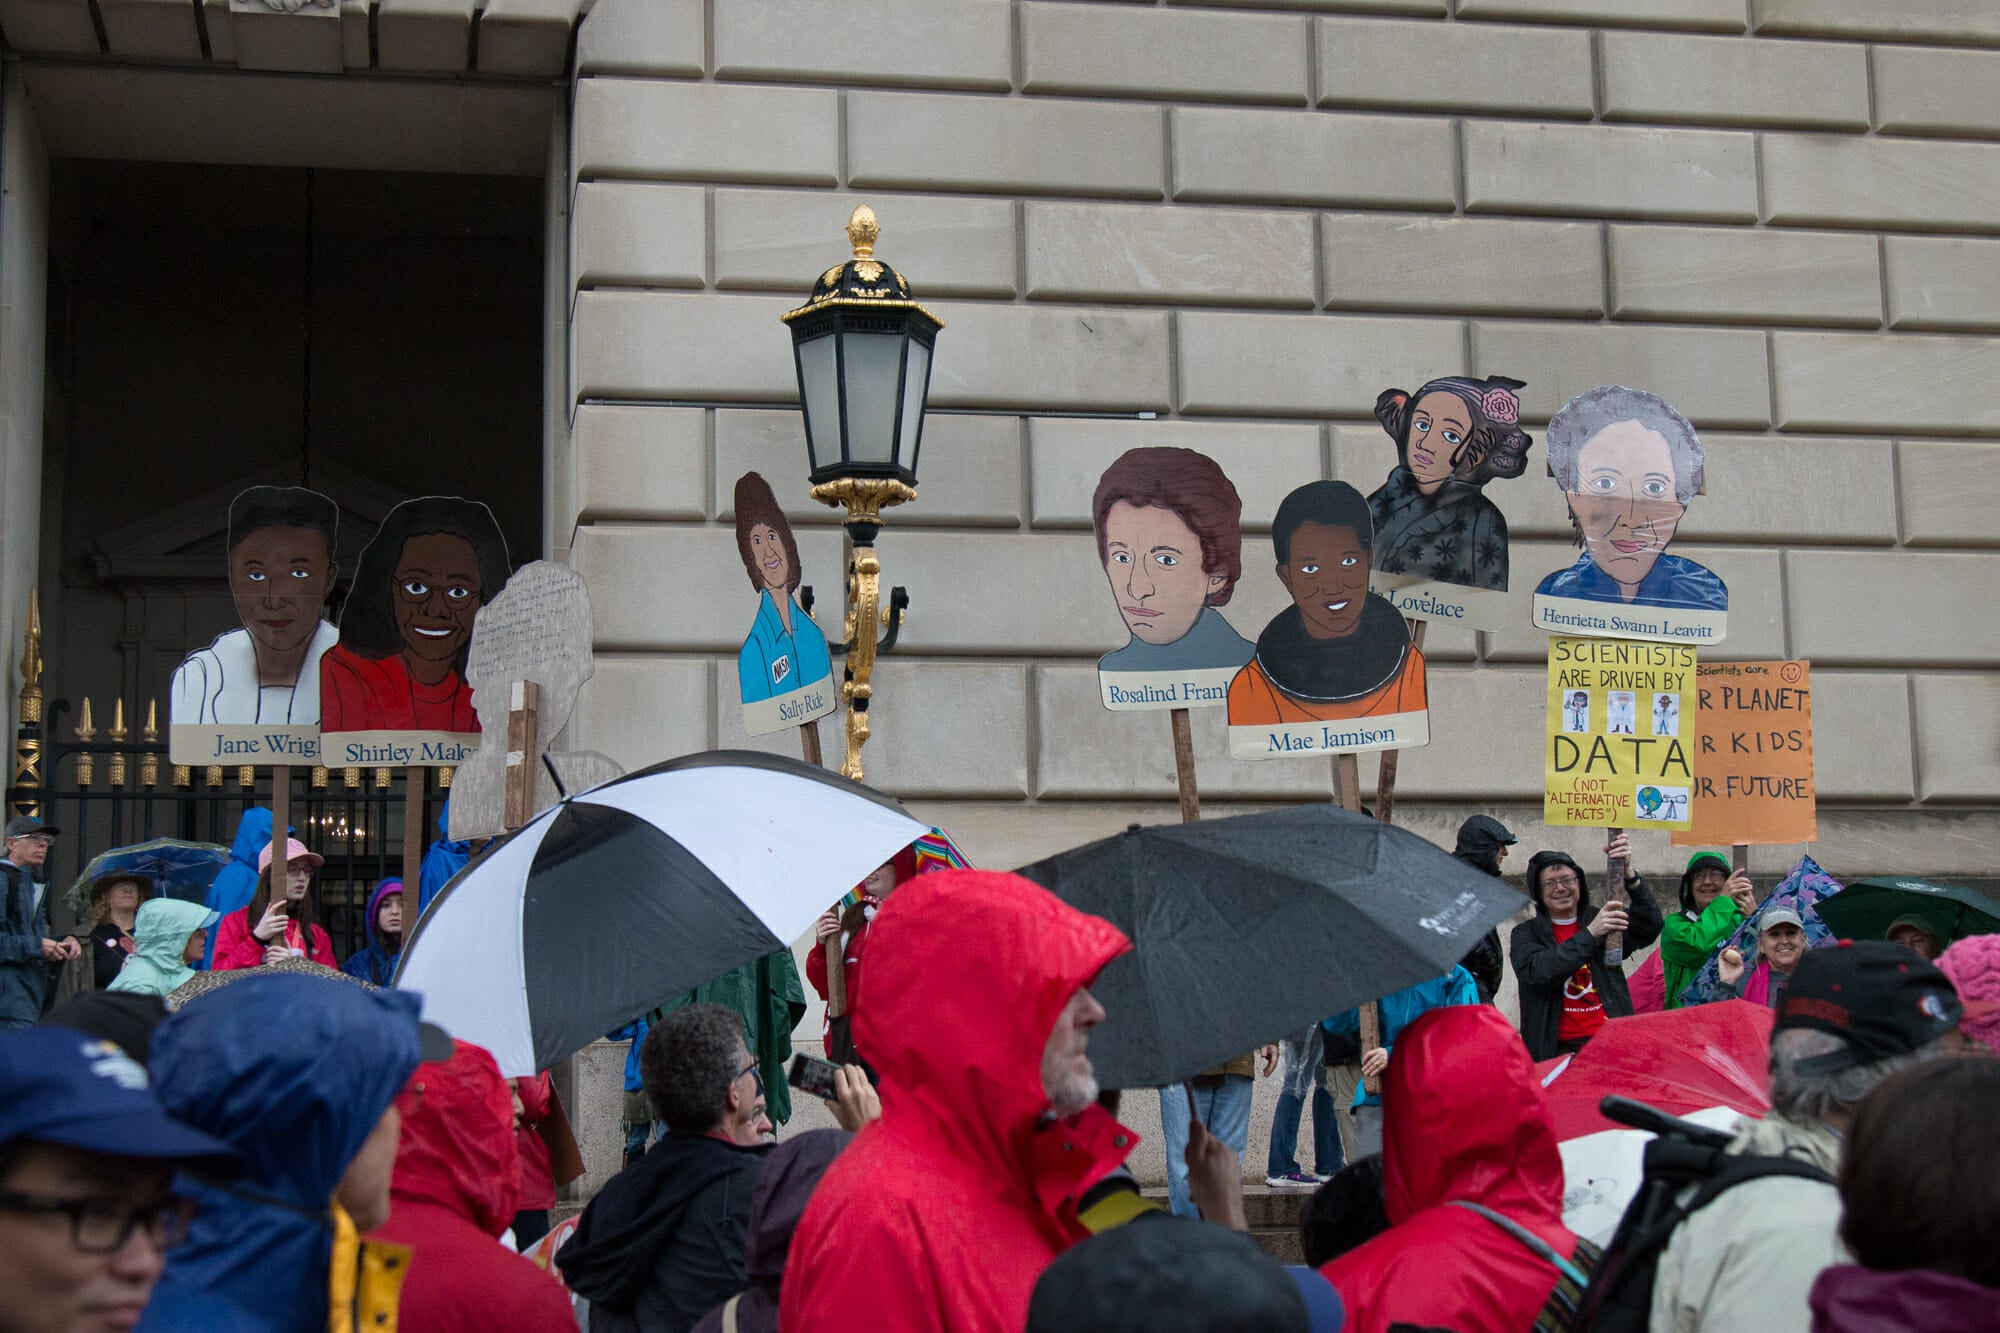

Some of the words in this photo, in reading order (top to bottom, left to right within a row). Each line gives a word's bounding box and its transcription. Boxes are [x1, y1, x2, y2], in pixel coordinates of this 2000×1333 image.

[1389, 589, 1465, 618] Lovelace
[1542, 607, 1606, 629] Henrietta
[1610, 616, 1657, 634] Swann
[1662, 621, 1713, 638] Leavitt
[1555, 641, 1693, 668] SCIENTISTS
[773, 658, 789, 682] NASA
[1558, 669, 1591, 688] ARE
[1600, 670, 1655, 689] DRIVEN
[1663, 672, 1685, 691] BY
[1696, 664, 1742, 677] Scientists
[779, 700, 804, 721] Sally
[804, 691, 824, 714] Ride
[1109, 684, 1177, 704] Rosalind
[1720, 686, 1809, 712] PLANET
[214, 734, 259, 757] Jane
[1268, 733, 1314, 752] Mae
[1321, 727, 1396, 750] Jamison
[1731, 730, 1803, 754] KIDS
[346, 742, 415, 765] Shirley
[420, 742, 478, 761] Malc
[1554, 735, 1691, 778] DATA
[1573, 777, 1608, 793] (NOT
[1727, 776, 1809, 801] FUTURE
[1566, 807, 1617, 823] FACTS")
